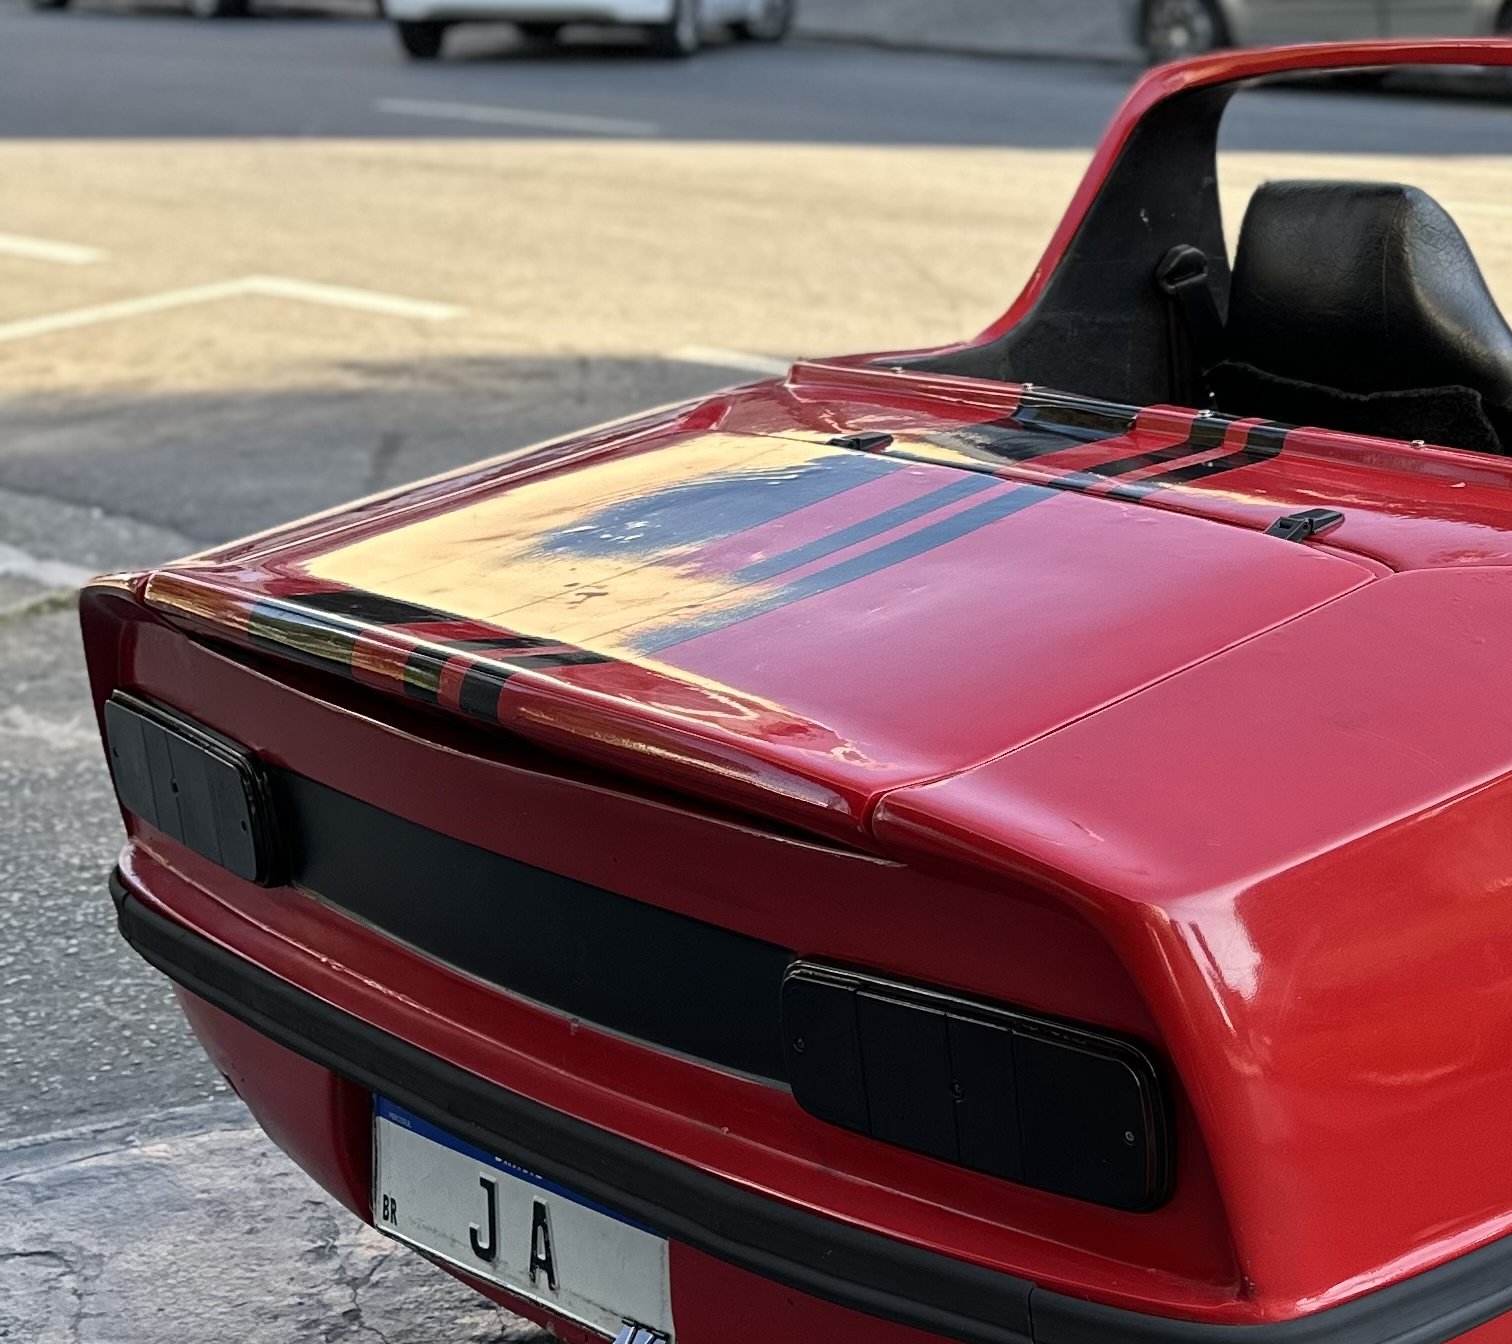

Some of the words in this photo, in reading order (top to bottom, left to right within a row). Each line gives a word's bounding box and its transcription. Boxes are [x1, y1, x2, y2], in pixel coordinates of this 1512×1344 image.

[382, 1193, 398, 1227] BR
[468, 1173, 497, 1263] J
[528, 1197, 559, 1291] A
